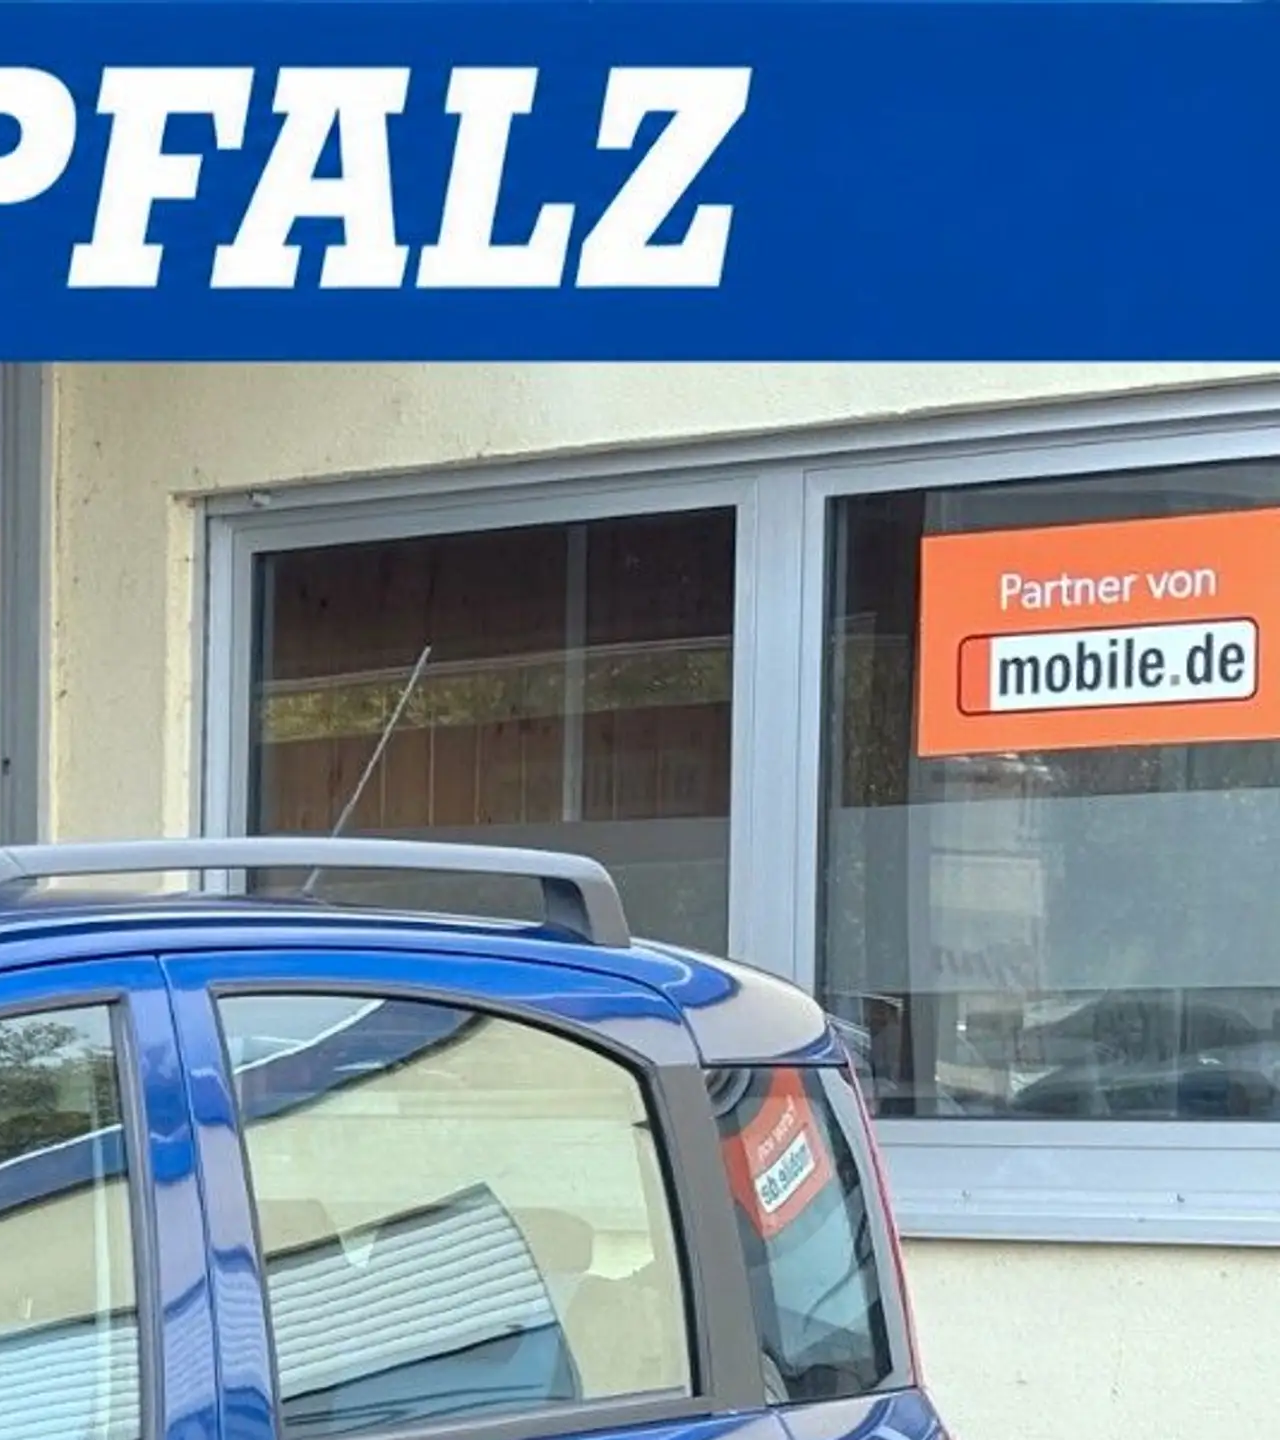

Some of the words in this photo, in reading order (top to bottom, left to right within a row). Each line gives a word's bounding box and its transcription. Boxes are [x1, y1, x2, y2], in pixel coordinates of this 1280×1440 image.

[1000, 572, 1138, 611] Partner
[1146, 567, 1217, 600] von
[998, 632, 1246, 697] mobile.de
